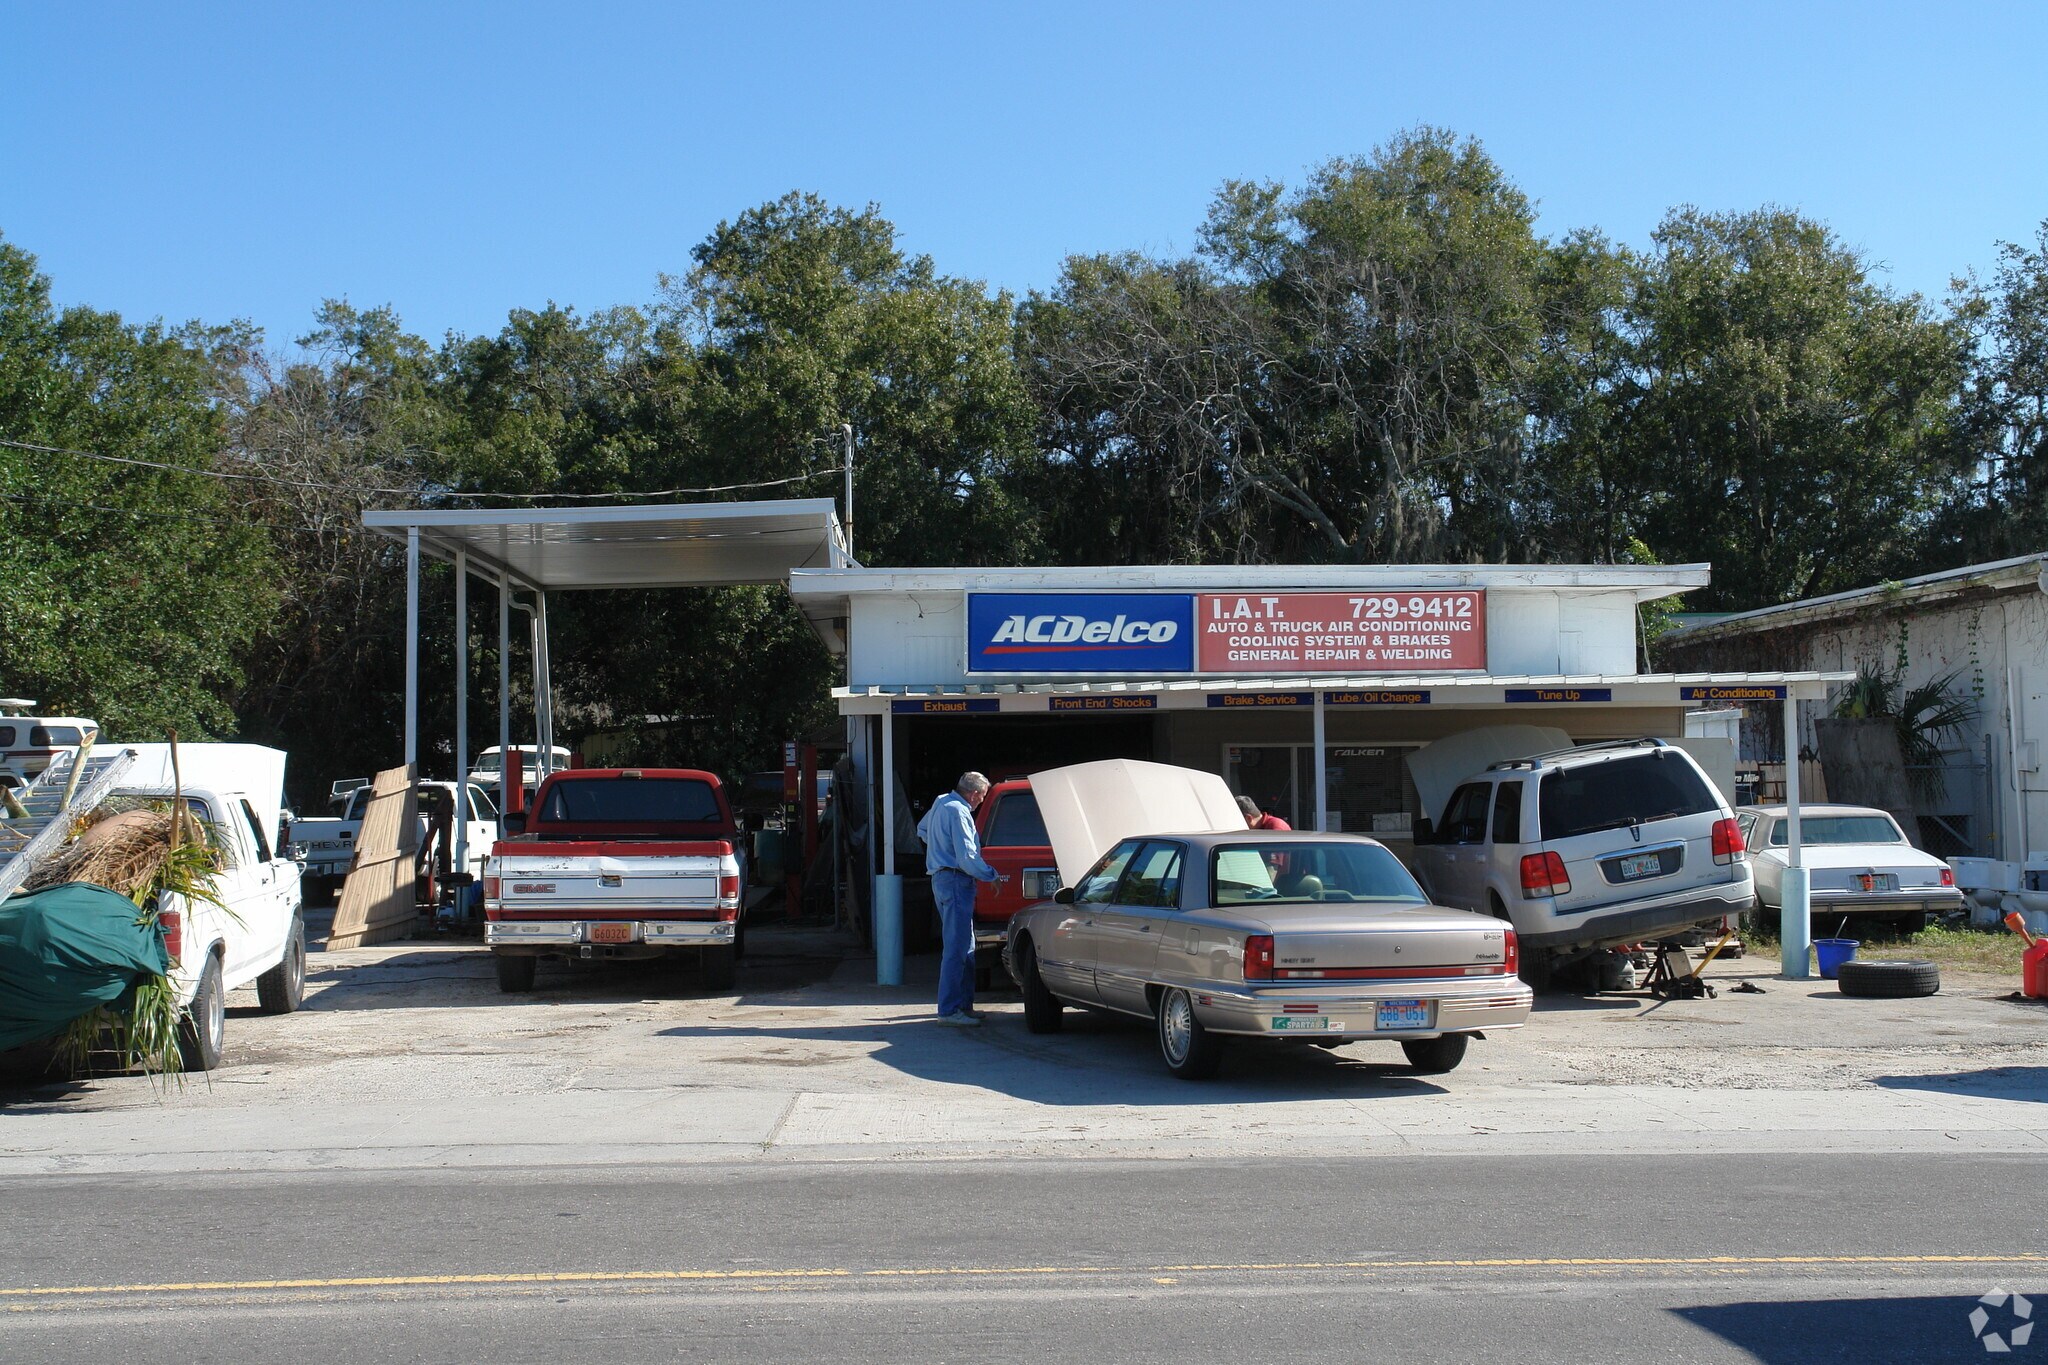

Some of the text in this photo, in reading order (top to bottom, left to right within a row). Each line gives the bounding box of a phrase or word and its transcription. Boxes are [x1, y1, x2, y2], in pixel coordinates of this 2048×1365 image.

[1213, 597, 1472, 619] I.A.T. 729-9412
[991, 614, 1178, 643] ACDelco
[1207, 621, 1472, 633] AUTO & TRUCK AIR CONDITIONING
[1228, 635, 1451, 647] COOLING SYSTEM & BRAKES
[1227, 648, 1452, 661] GENERAL REPAIR & WELDING
[1381, 692, 1422, 704] Change
[1536, 690, 1580, 701] Tune Up
[1692, 687, 1776, 699] Air Conditioning
[1054, 699, 1082, 709] Front
[1224, 694, 1297, 706] Brake Service
[924, 701, 967, 712] Exhaust
[512, 884, 557, 894] GMC
